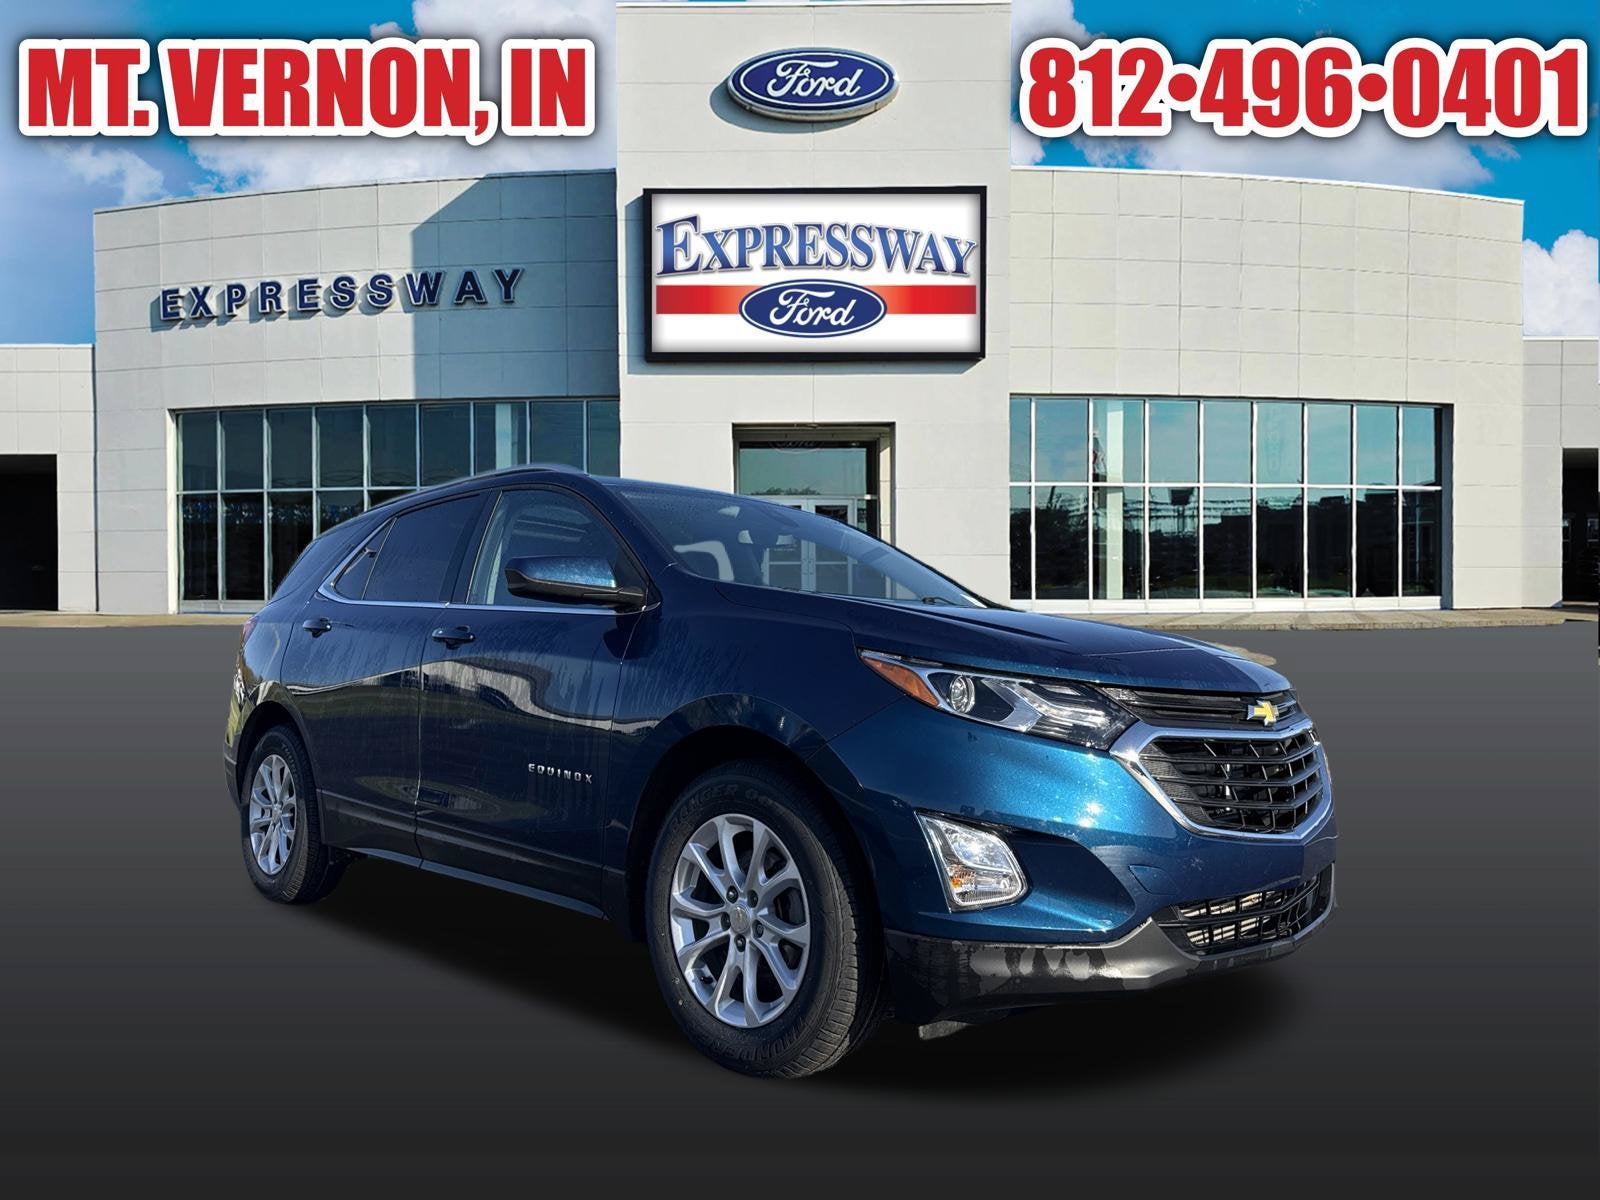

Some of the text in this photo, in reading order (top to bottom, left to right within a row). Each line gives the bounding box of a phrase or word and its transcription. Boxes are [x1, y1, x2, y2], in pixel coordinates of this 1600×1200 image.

[766, 58, 865, 98] Ford
[655, 214, 977, 278] EXPRESSWAY
[159, 268, 526, 322] EXPRESSWAY
[768, 287, 858, 327] Ford
[527, 762, 593, 784] EQUINOX
